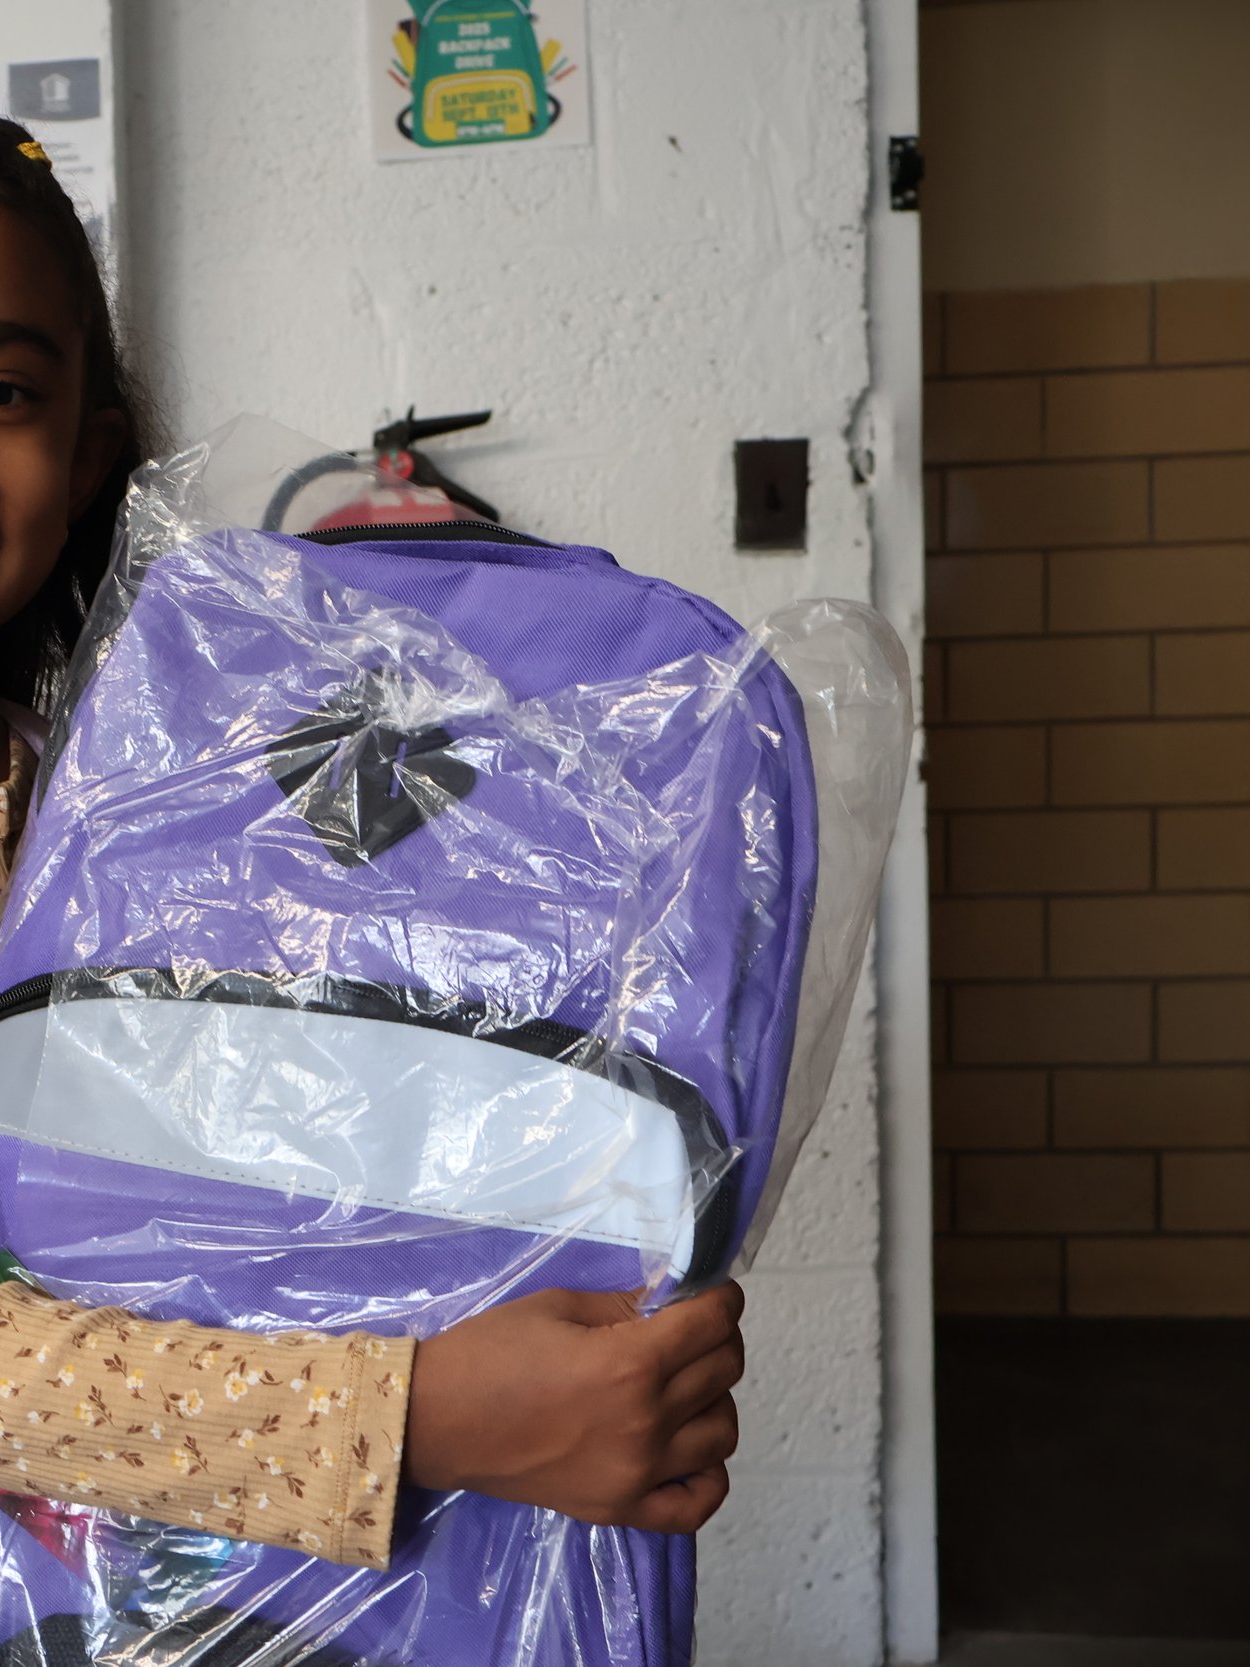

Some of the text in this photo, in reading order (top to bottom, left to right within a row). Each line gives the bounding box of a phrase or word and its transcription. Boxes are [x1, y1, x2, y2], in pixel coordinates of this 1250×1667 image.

[439, 37, 511, 54] BACKPACK
[456, 55, 494, 69] DRIVE
[442, 89, 516, 106] SATURDAY
